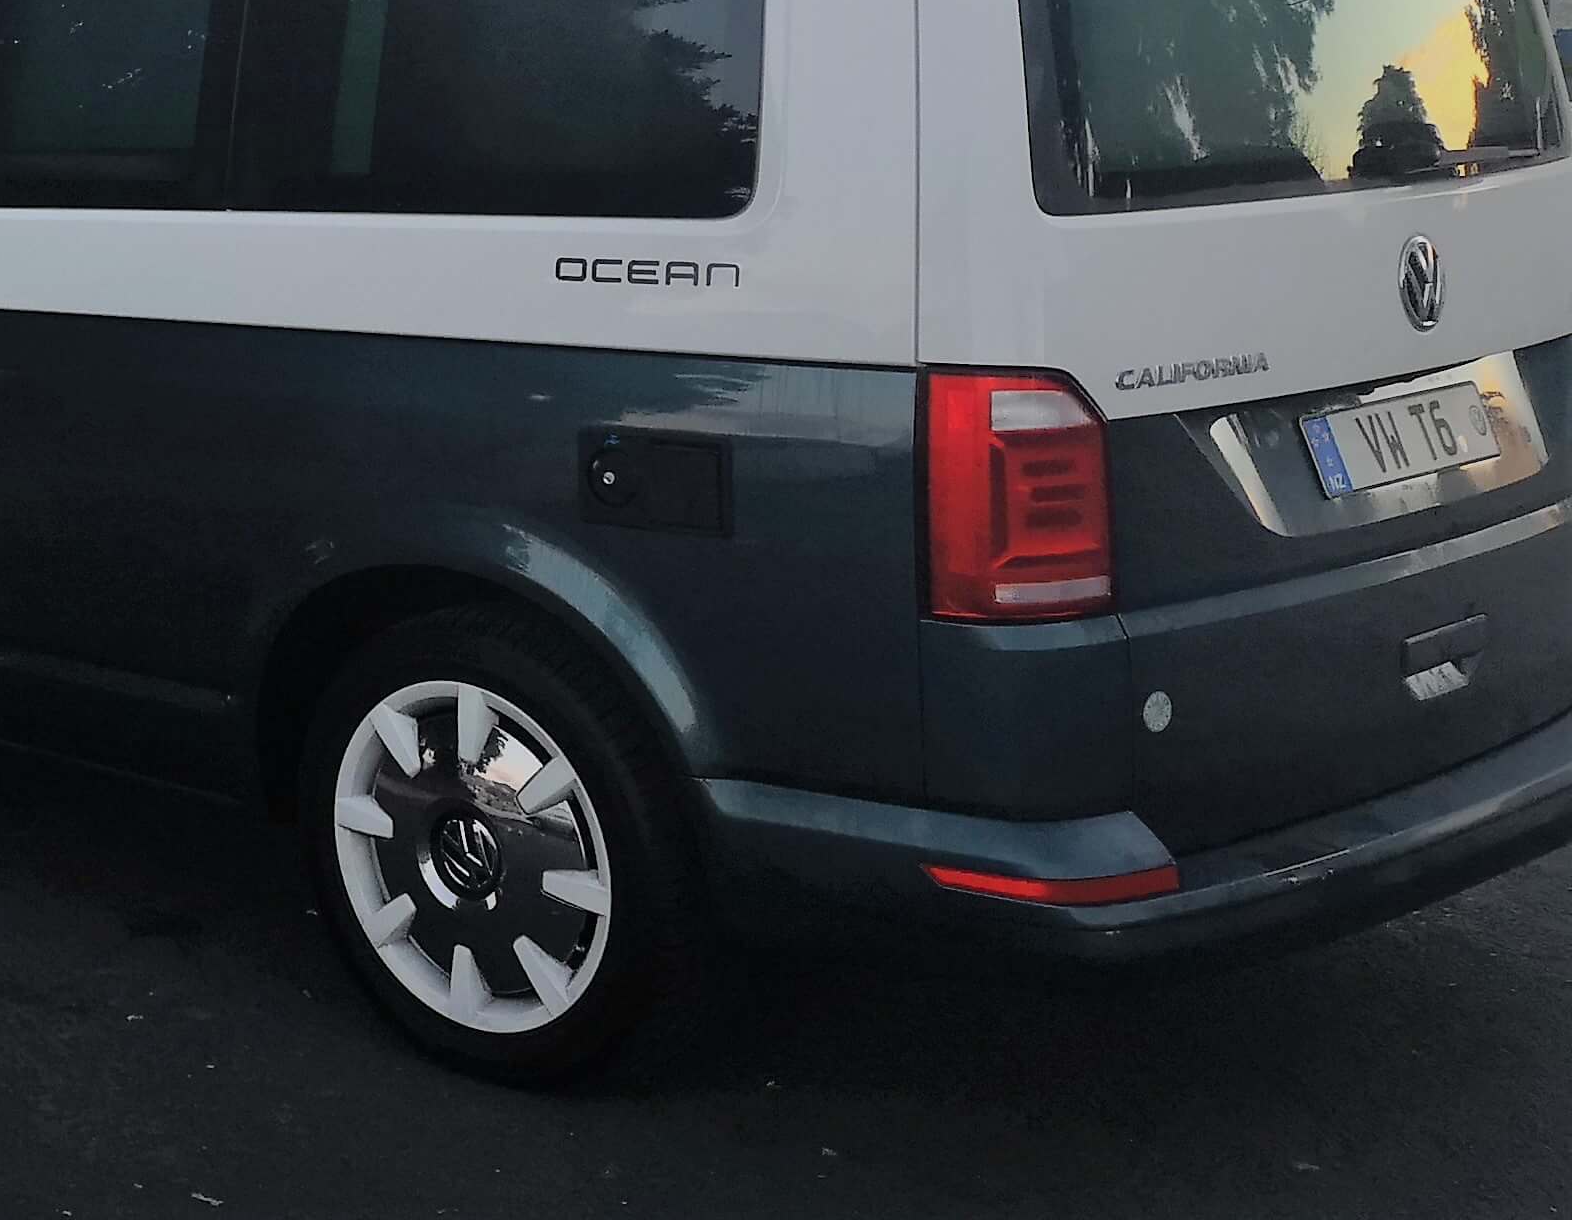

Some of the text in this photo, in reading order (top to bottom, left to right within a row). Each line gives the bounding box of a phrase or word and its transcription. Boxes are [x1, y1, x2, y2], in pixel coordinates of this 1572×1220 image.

[555, 257, 740, 287] OCEAN
[1115, 352, 1270, 391] CALIFORNIA
[1356, 411, 1410, 473] VW
[1407, 400, 1457, 461] T6
